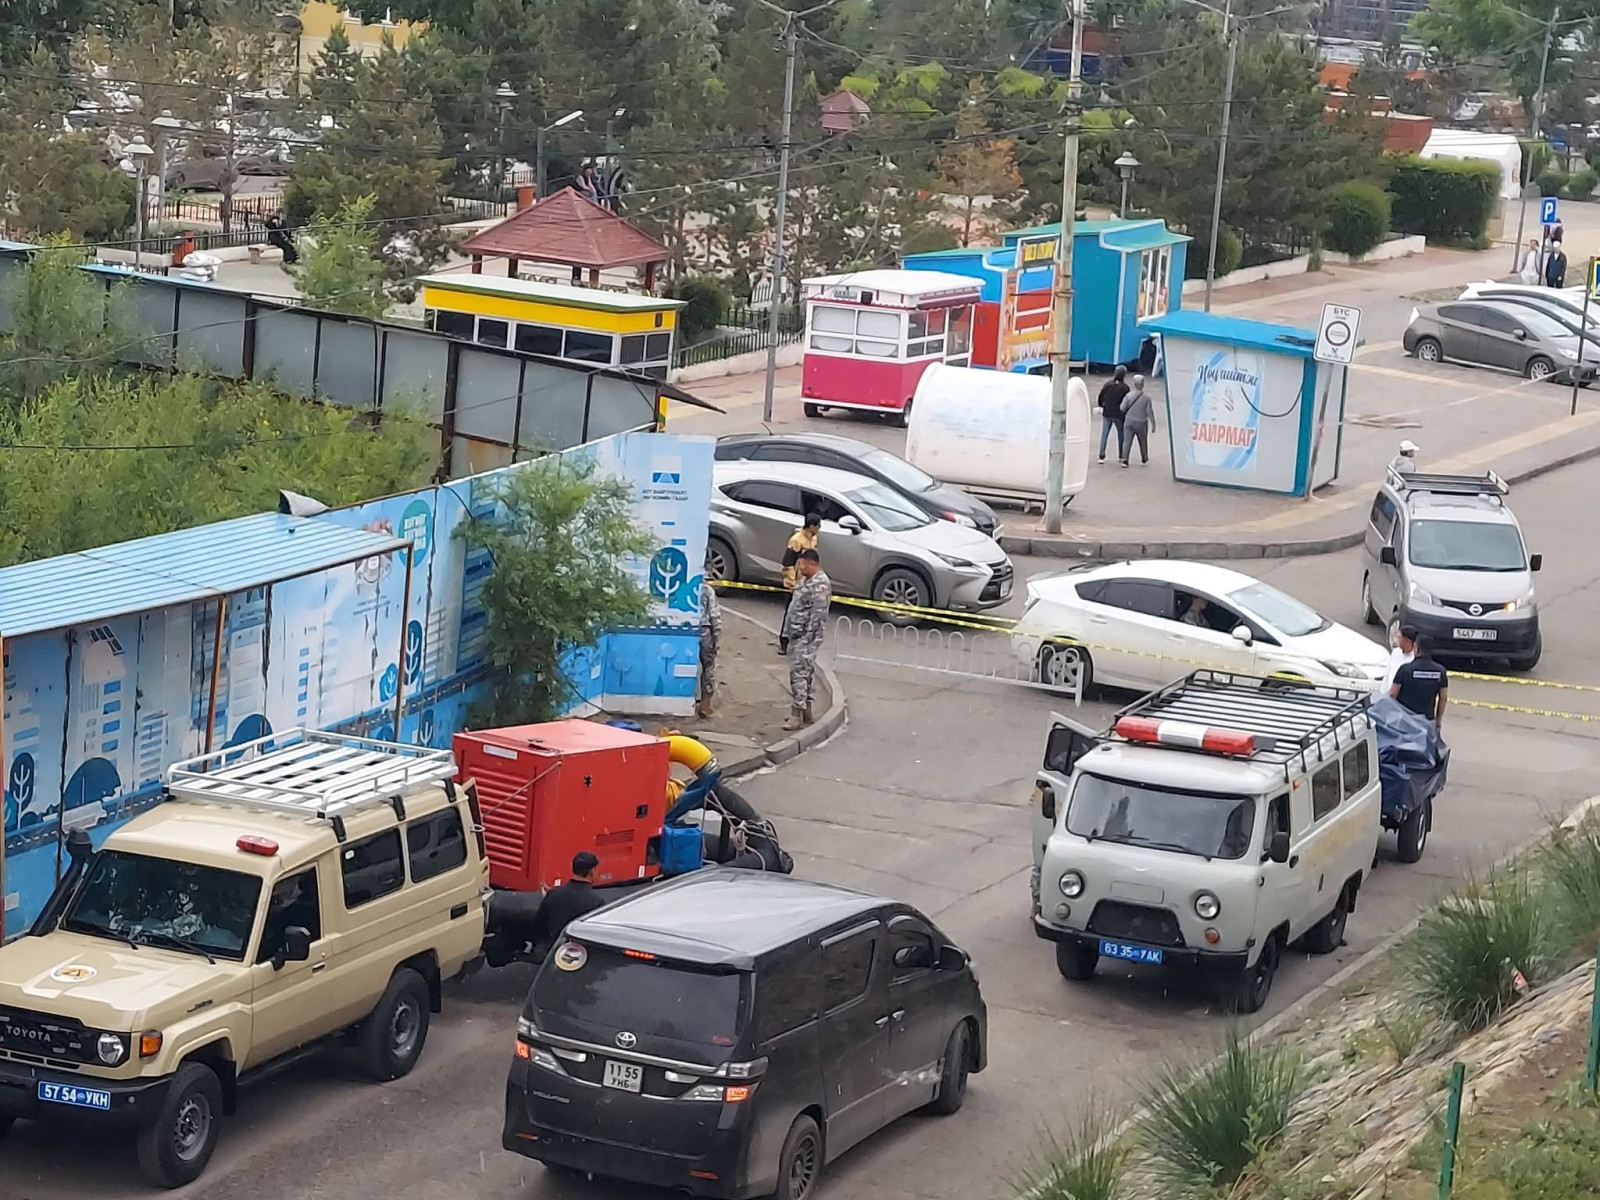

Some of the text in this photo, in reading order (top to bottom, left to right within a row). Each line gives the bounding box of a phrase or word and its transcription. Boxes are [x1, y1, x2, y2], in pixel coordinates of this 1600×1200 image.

[1544, 201, 1554, 221] P
[1191, 418, 1255, 447] ЗАЙРМАГ
[1104, 942, 1160, 962] 63 35 УАК
[5, 1024, 51, 1043] TOYOTA
[609, 1063, 639, 1080] 11 55
[44, 1084, 108, 1108] 57 54 УКН
